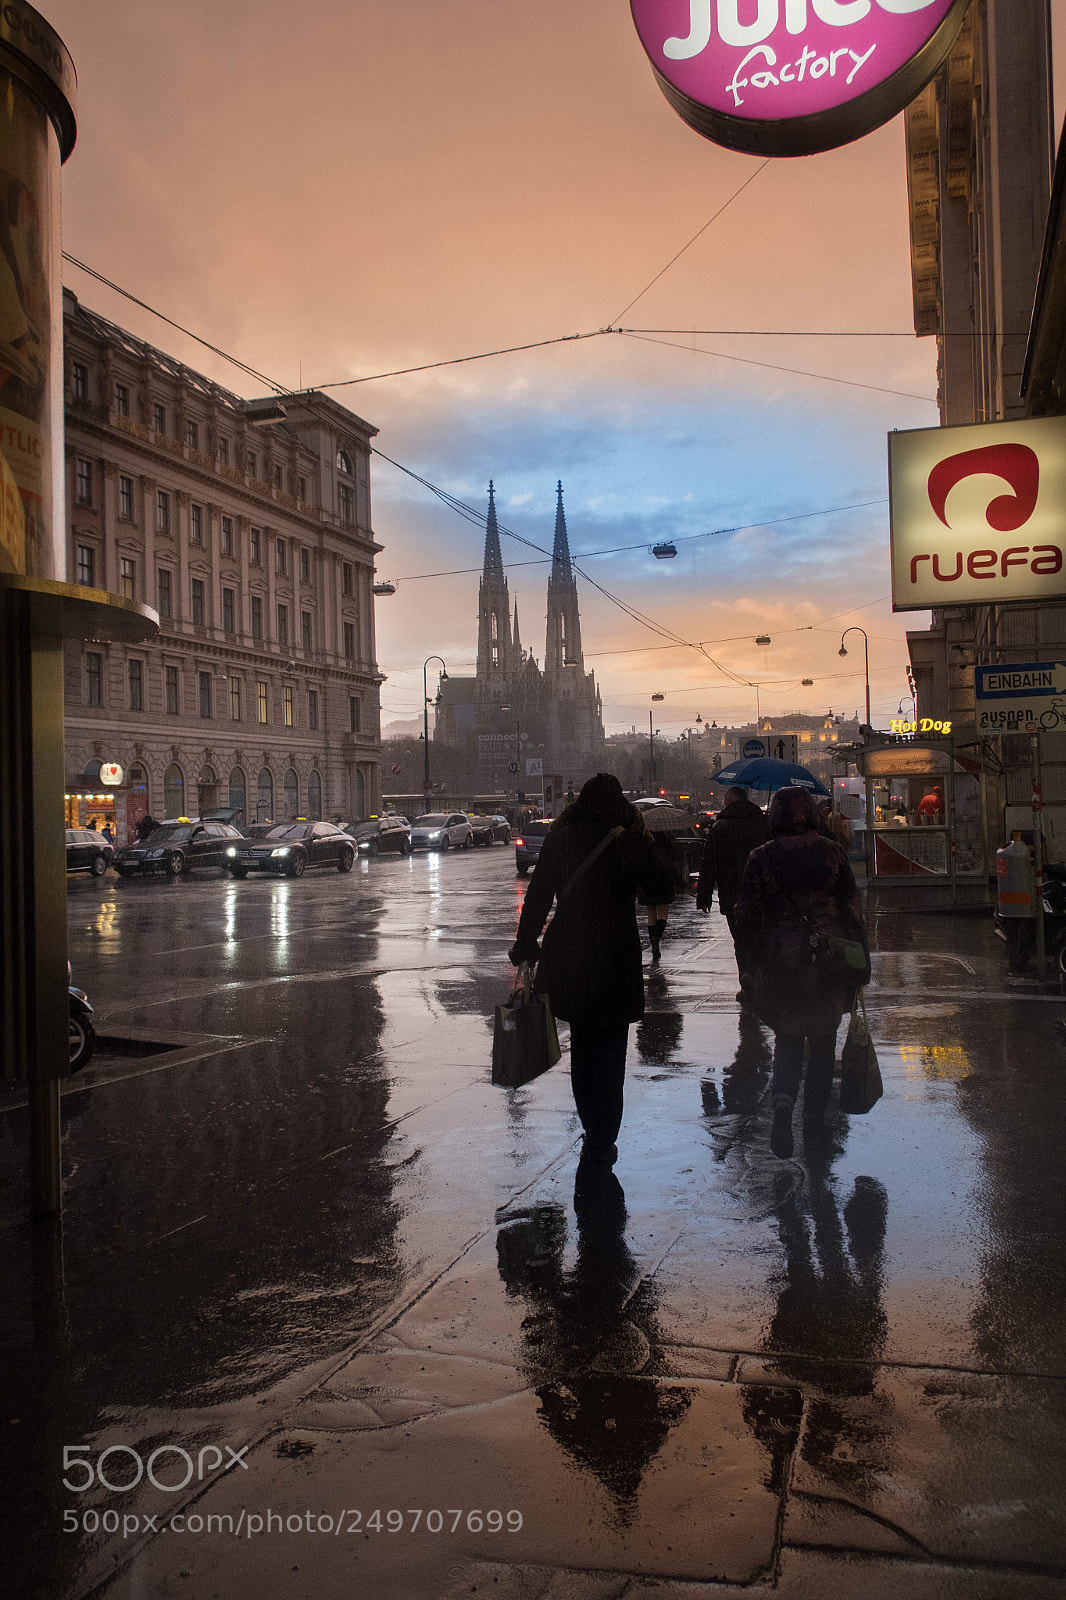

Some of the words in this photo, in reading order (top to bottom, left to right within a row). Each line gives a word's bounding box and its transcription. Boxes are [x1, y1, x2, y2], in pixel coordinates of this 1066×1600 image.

[725, 43, 877, 107] factory
[910, 544, 1063, 584] ruefa
[988, 671, 1052, 690] EINBAHN
[889, 719, 918, 735] Hot
[920, 718, 952, 735] Dog
